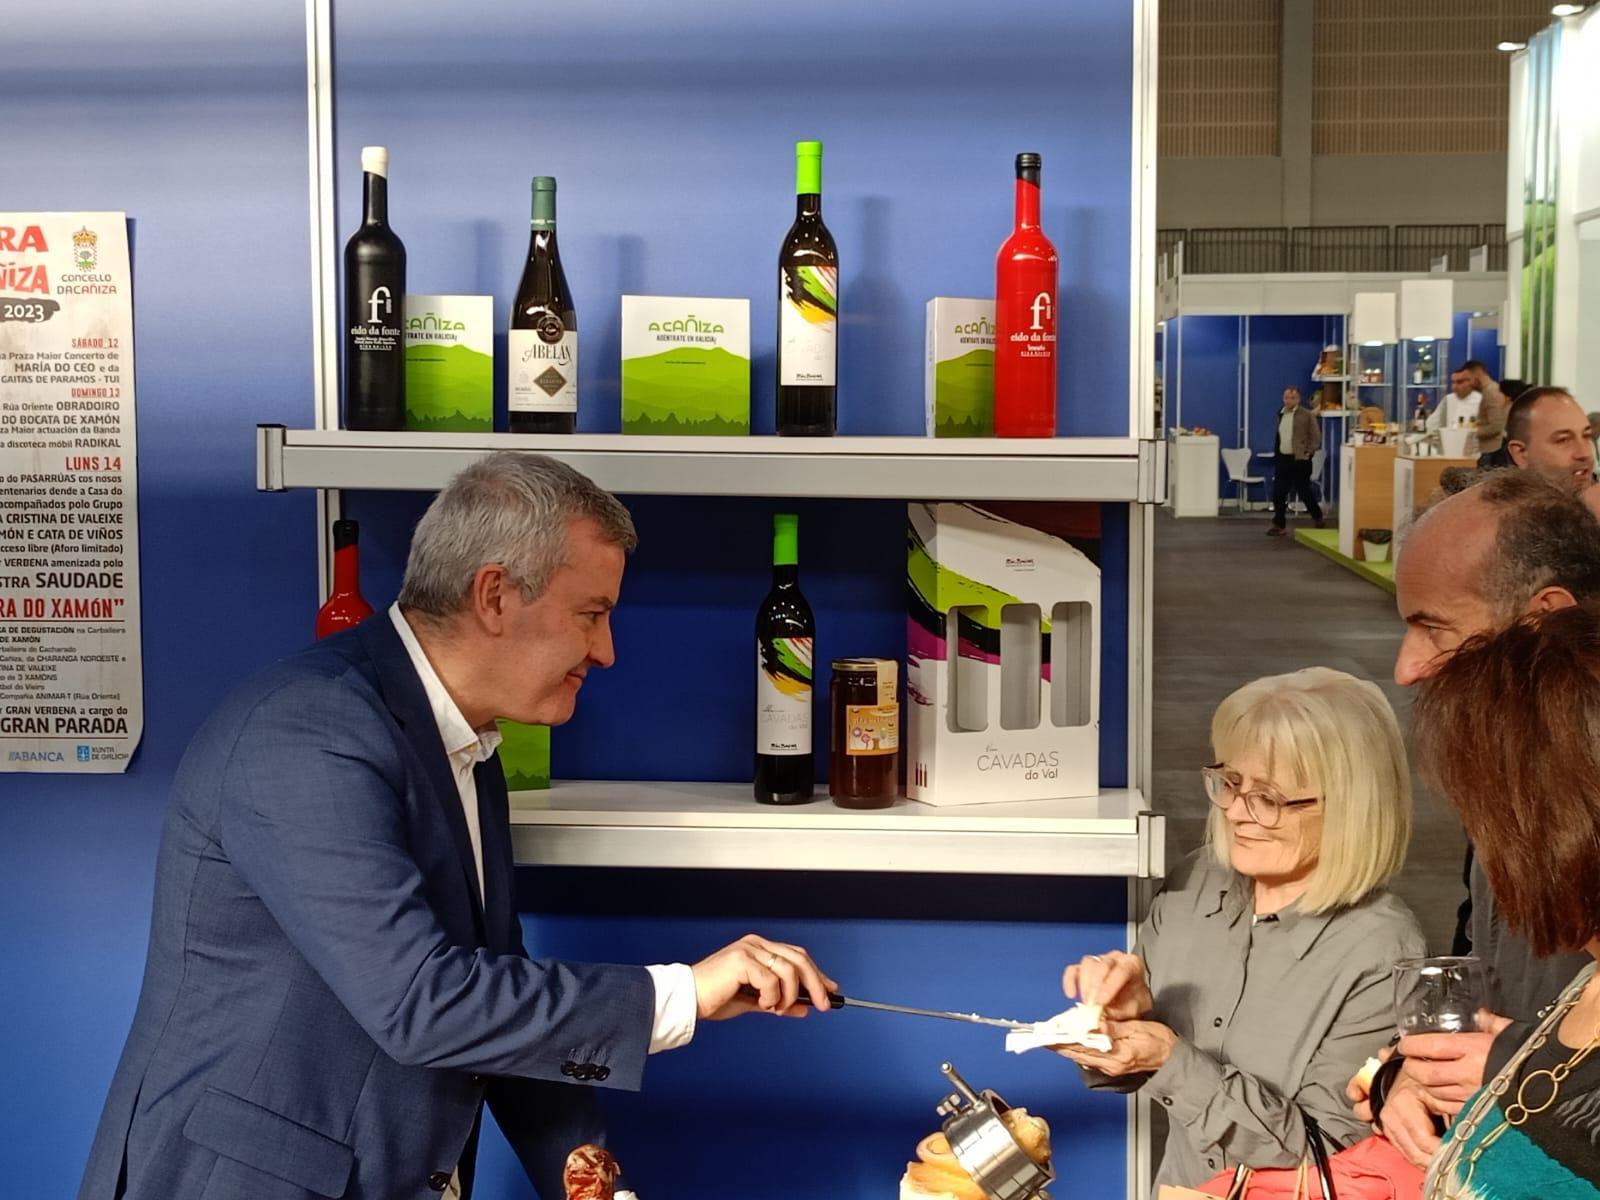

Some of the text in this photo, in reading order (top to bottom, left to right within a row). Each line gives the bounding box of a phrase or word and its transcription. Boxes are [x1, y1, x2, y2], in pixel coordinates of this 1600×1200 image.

[61, 274, 111, 282] CONCELLO
[4, 304, 44, 322] 2023
[648, 314, 724, 333] A CAÑIZA
[369, 326, 379, 335] da
[1030, 332, 1041, 341] da
[64, 352, 105, 360] Concerto
[107, 352, 119, 360] de
[15, 360, 51, 372] MARÍA
[55, 363, 70, 372] DO
[73, 363, 96, 372] CEO
[108, 364, 119, 372] da
[36, 375, 48, 384] DE
[51, 375, 96, 384] PARAMOS
[104, 375, 120, 384] TUI
[71, 388, 107, 398] DOMINGO
[3, 402, 120, 411] Rúa Oriente OBRADOIRO
[2, 413, 120, 424] DO BOCATA DE XAMÓN
[11, 426, 35, 434] Maior
[37, 426, 79, 434] actuación
[80, 426, 91, 434] da
[93, 426, 120, 434] Banda
[7, 440, 46, 448] discoteca
[75, 439, 121, 448] RADIKAL
[66, 457, 121, 471] LUNS 14
[7, 474, 18, 483] do
[20, 472, 76, 483] PASARRÚAS
[78, 475, 93, 483] cos
[96, 475, 122, 483] nosos
[49, 486, 77, 495] dende
[88, 487, 108, 495] Casa
[111, 486, 123, 495] do
[68, 500, 90, 511] polo
[93, 500, 123, 511] Grupo
[6, 513, 57, 524] CRISTINA
[60, 513, 75, 524] DE
[78, 513, 123, 524] VALEIXE
[28, 529, 34, 539] E
[38, 529, 65, 539] CATA
[68, 529, 84, 539] DE
[87, 527, 123, 539] VIÑOS
[28, 544, 48, 553] libre
[51, 544, 79, 554] (Aforo
[82, 544, 123, 554] limitado)
[4, 558, 124, 569] VERBENA amenizada polo
[36, 573, 123, 588] SAUDADE
[24, 598, 45, 618] DO
[6, 706, 31, 714] GRAN
[35, 706, 76, 714] VERBENA
[89, 707, 113, 716] cargo
[117, 706, 128, 714] do
[0, 718, 128, 733] GRAN PARADA
[977, 751, 1059, 771] CAVADAS
[1025, 768, 1058, 780] do Val
